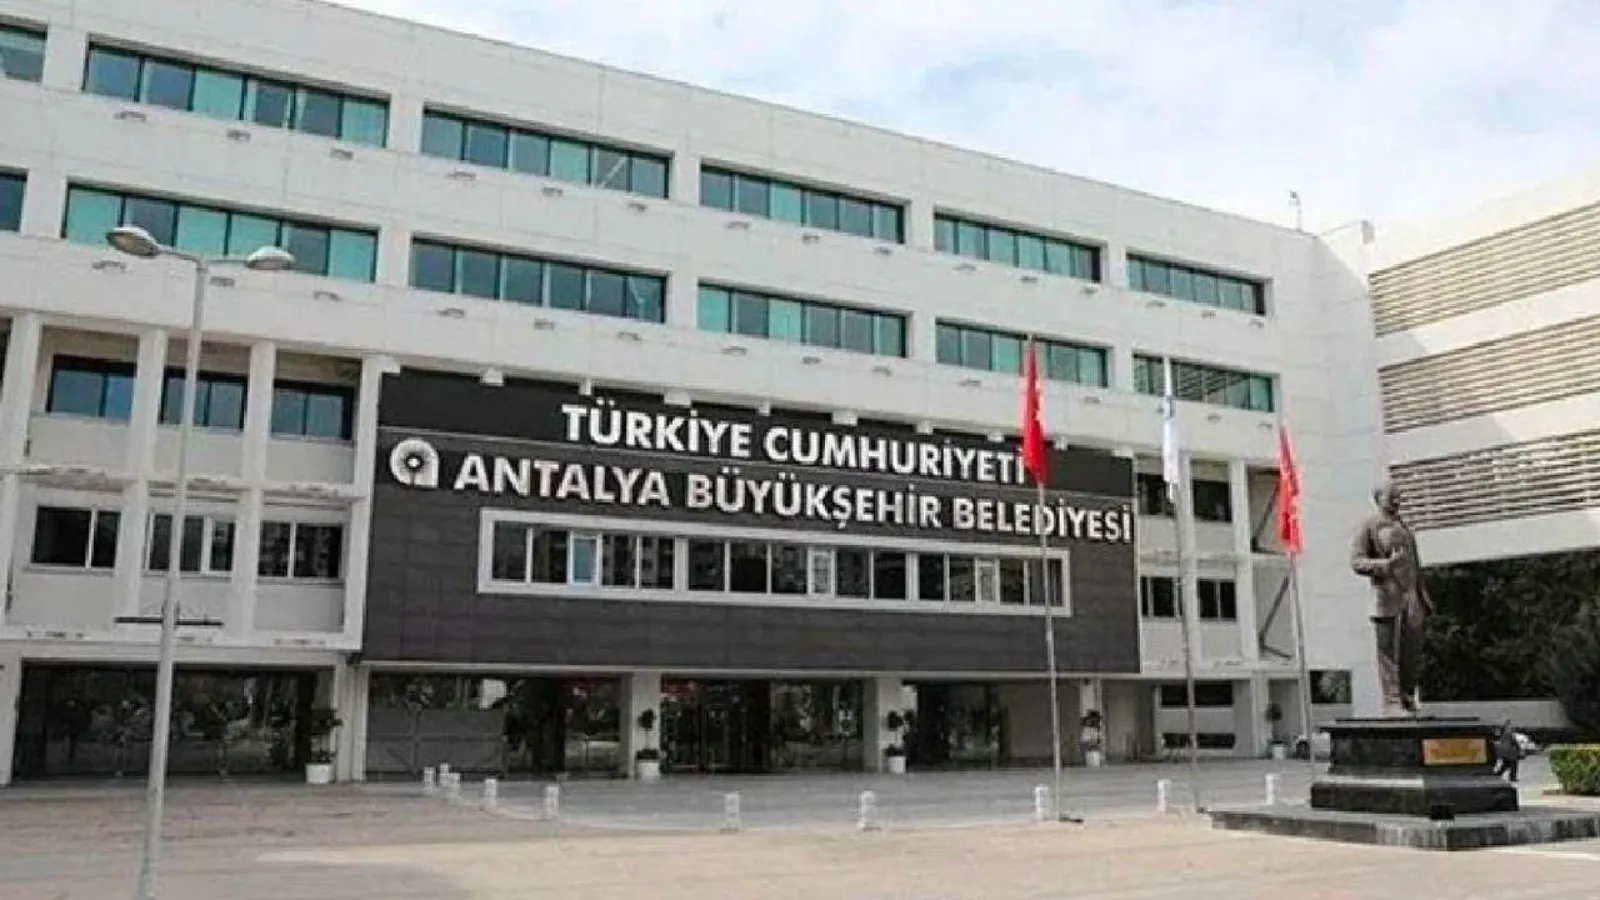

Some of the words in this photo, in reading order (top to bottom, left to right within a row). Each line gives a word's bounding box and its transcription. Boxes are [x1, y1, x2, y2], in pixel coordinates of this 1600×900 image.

[562, 399, 751, 457] TÜRKİYE
[764, 426, 1025, 484] CUMHURİYETİ
[453, 455, 670, 507] ANTALYA
[687, 466, 942, 529] BÜYÜKŞEHİR
[953, 497, 1132, 541] BELEDİYESİ
